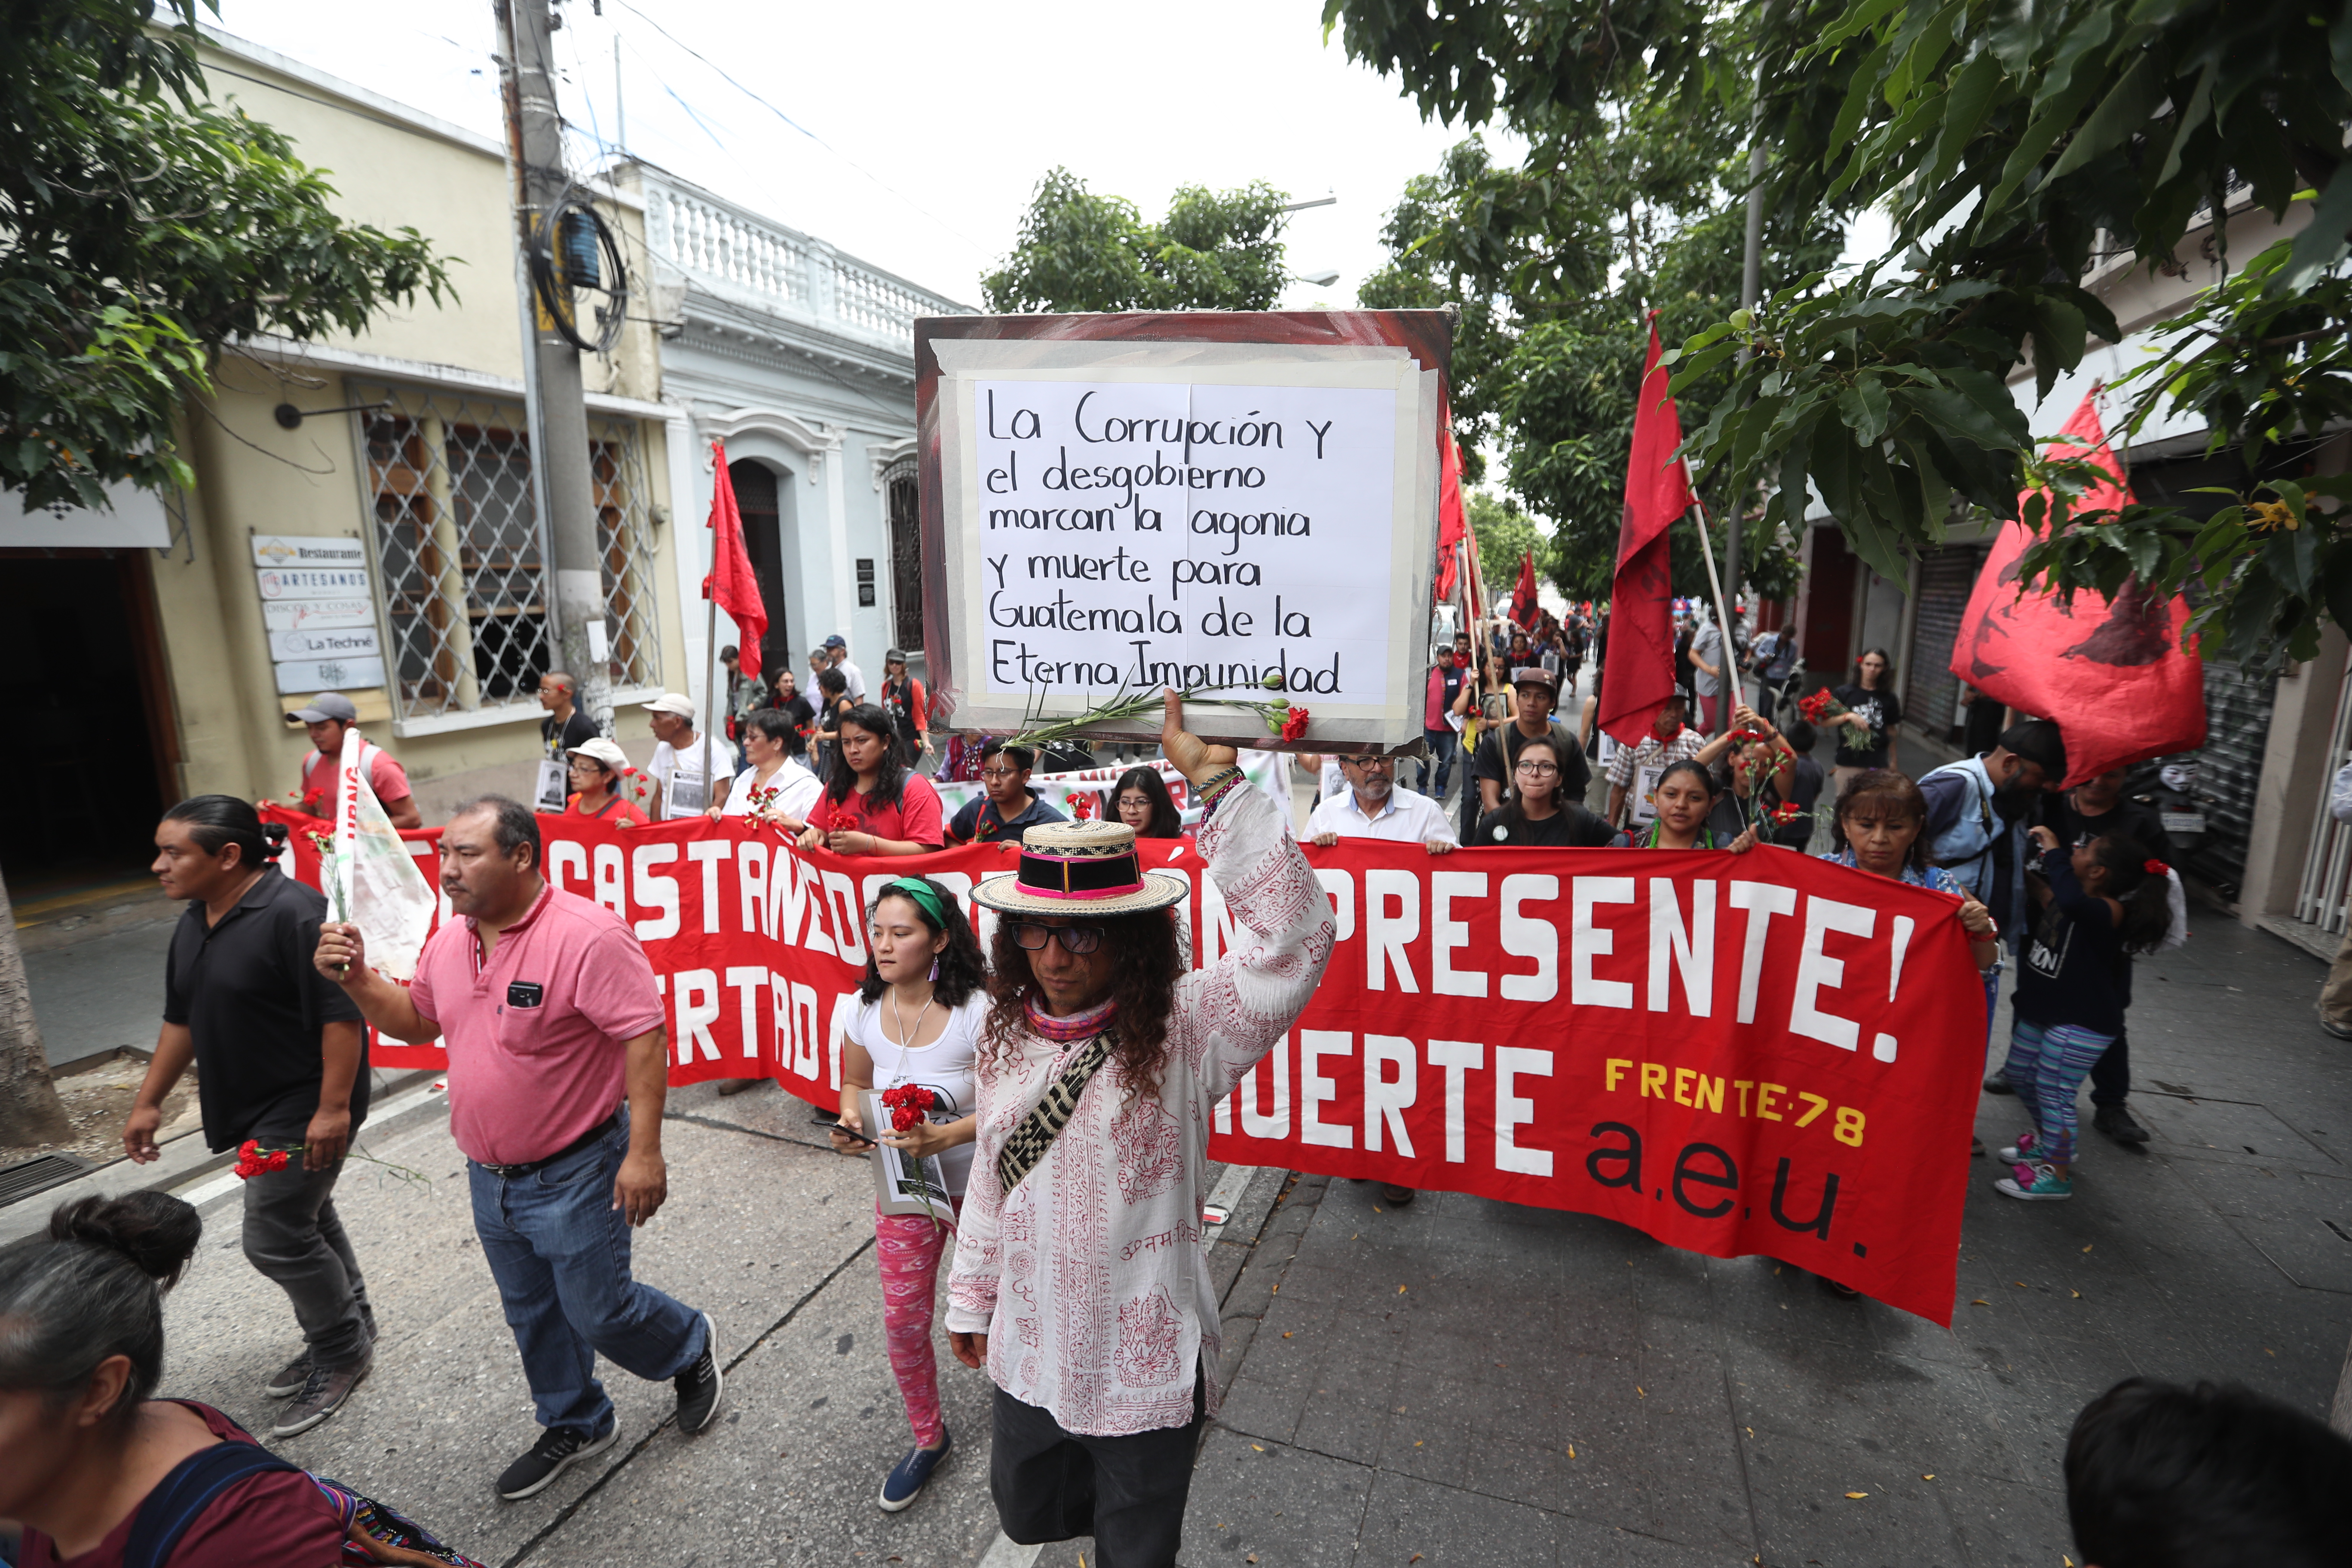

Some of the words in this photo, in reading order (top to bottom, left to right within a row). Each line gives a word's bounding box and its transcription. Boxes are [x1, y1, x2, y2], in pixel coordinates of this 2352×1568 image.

[988, 389, 1041, 438] La
[1075, 392, 1283, 463] Corrupción
[987, 450, 1017, 493] el
[1043, 446, 1265, 509] desgobierno
[990, 508, 1114, 532] marcan
[1135, 493, 1161, 531] la
[299, 548, 362, 559] Restaurante
[1028, 547, 1151, 582] muerte
[1173, 560, 1260, 600] para
[282, 573, 365, 586] ARTESANOS
[990, 589, 1182, 633] Guatemala
[1202, 597, 1253, 636] de
[1276, 595, 1311, 637] la
[308, 639, 325, 650] La
[325, 635, 373, 647] Techné
[993, 640, 1118, 684] Eterna
[1130, 641, 1342, 693] Impunidad
[1215, 1029, 1553, 1177] UERTE
